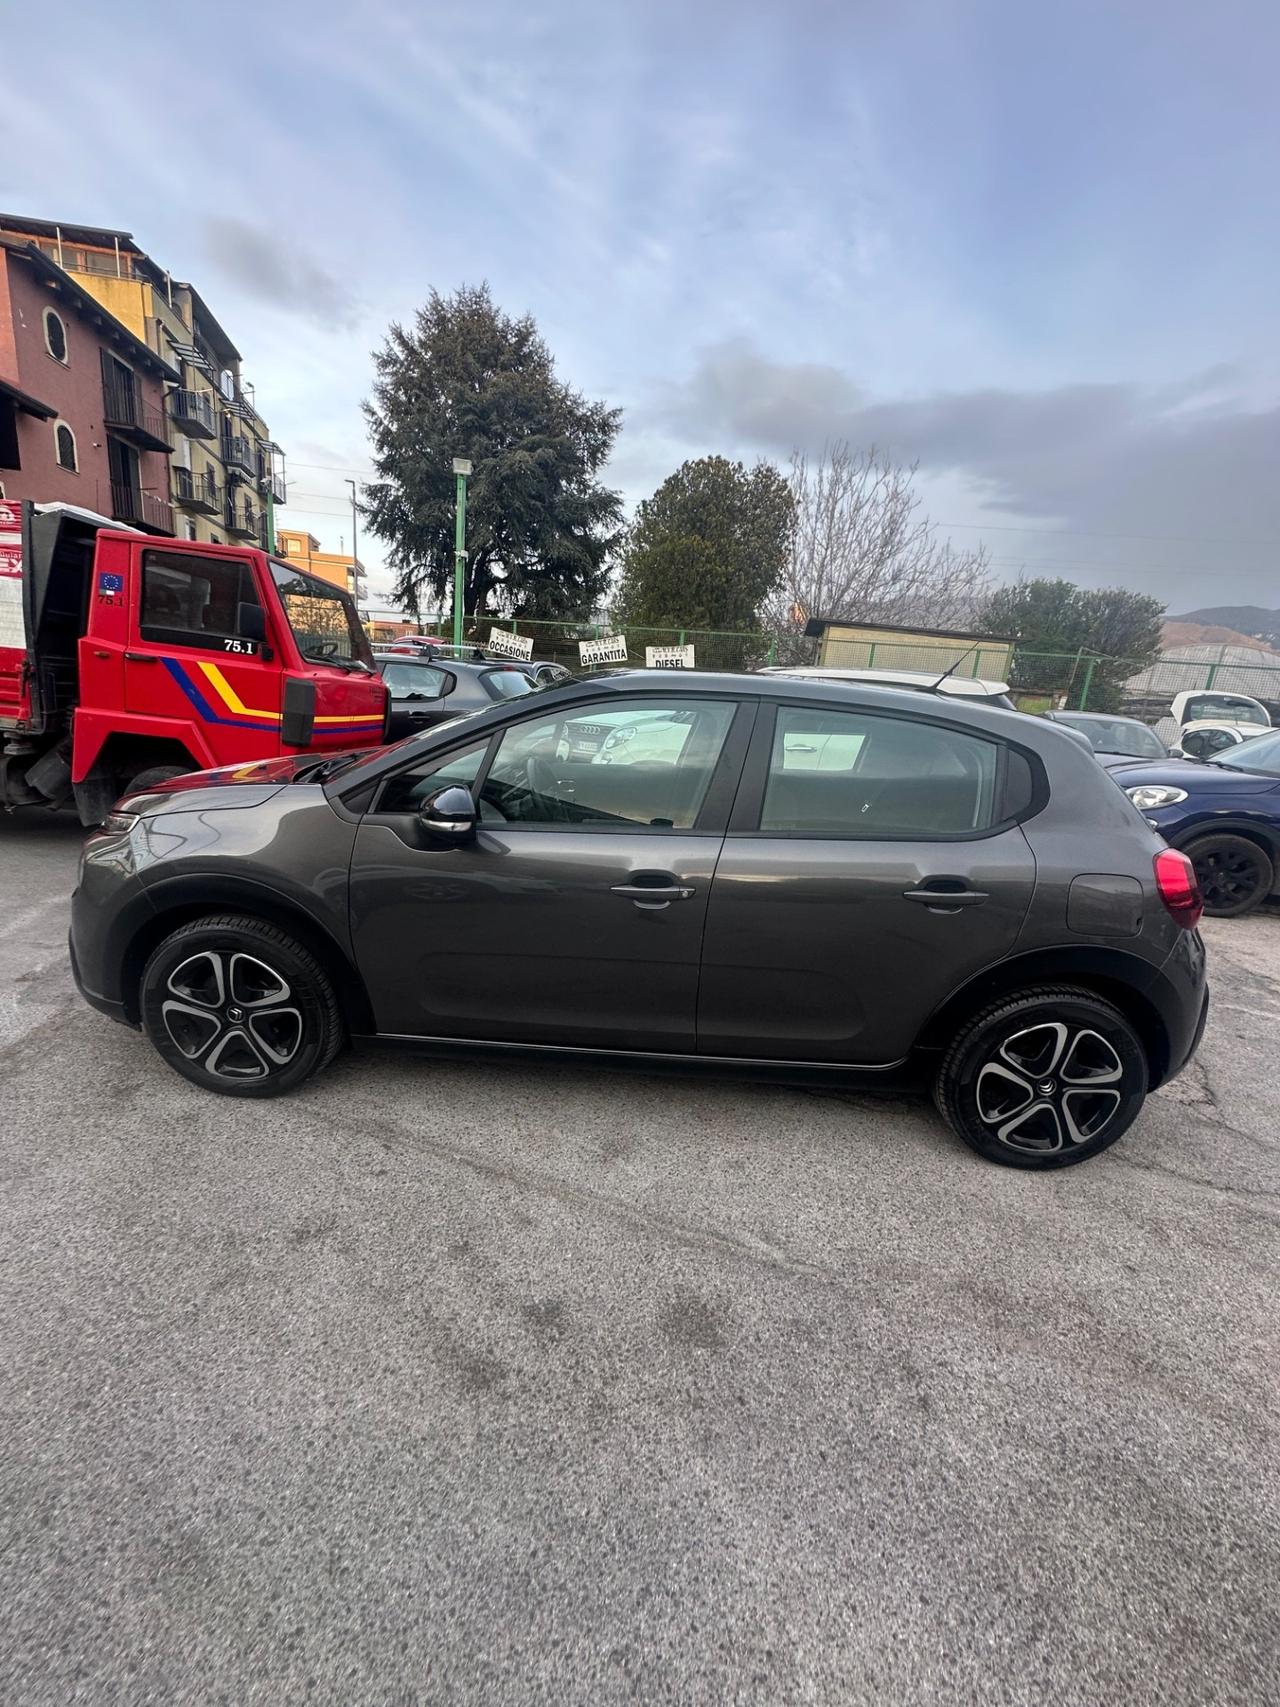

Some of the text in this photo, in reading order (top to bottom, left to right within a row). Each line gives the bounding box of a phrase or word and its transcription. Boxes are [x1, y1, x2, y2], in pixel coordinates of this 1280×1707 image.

[98, 594, 123, 607] 75.1
[224, 639, 253, 655] 75.1
[489, 640, 531, 661] OCCASIONE
[581, 648, 627, 665] GARANTITA
